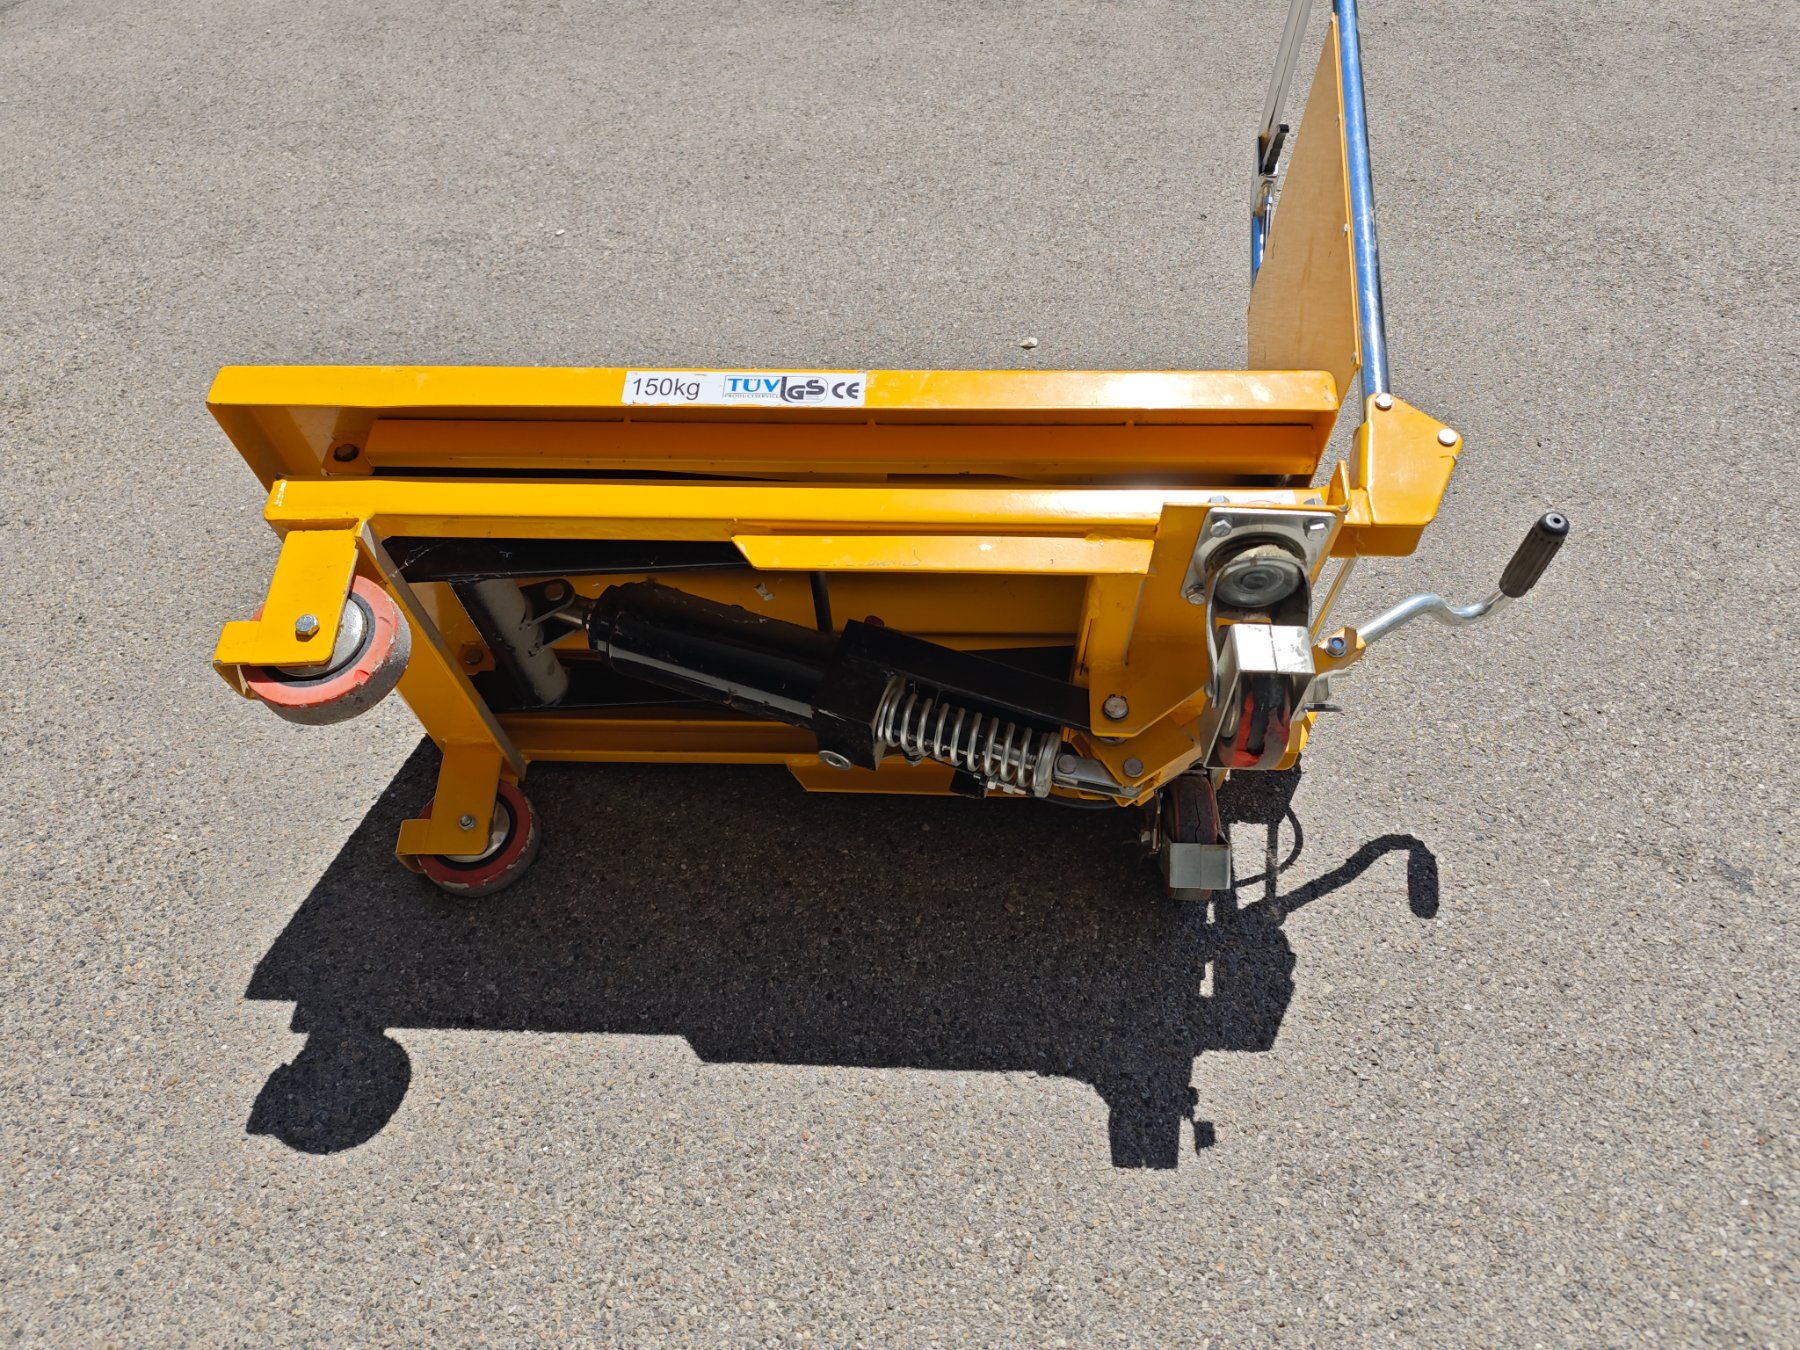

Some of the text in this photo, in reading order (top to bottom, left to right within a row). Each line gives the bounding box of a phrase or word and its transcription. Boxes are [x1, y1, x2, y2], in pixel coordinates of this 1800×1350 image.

[633, 378, 700, 400] 150kg
[787, 379, 825, 400] GS
[831, 382, 859, 399] CE
